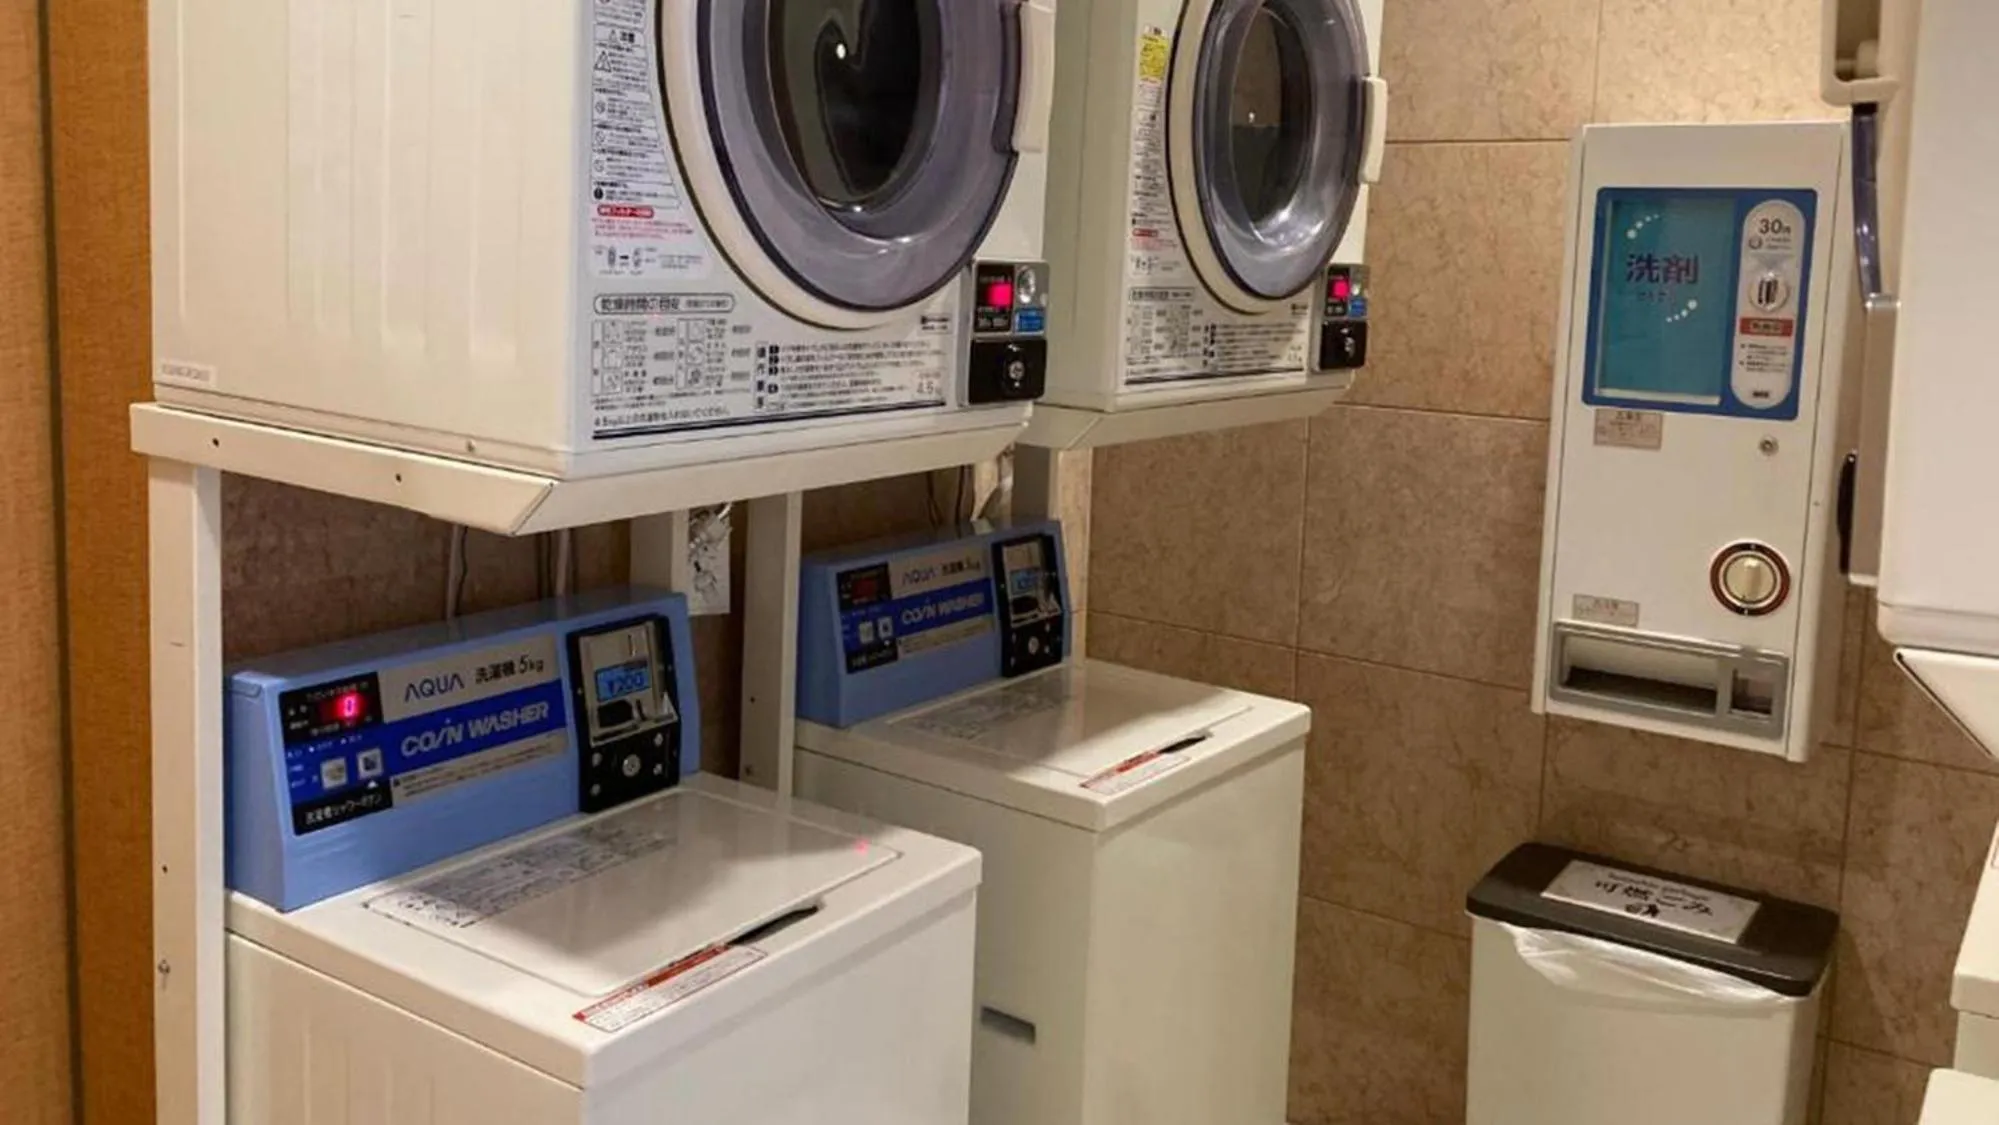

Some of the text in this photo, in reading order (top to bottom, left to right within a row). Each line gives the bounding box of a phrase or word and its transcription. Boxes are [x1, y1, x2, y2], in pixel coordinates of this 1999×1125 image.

[1626, 253, 1698, 284] 洗剤
[405, 671, 465, 702] AQUA
[518, 654, 545, 674] 5kg
[467, 701, 550, 739] WASHER
